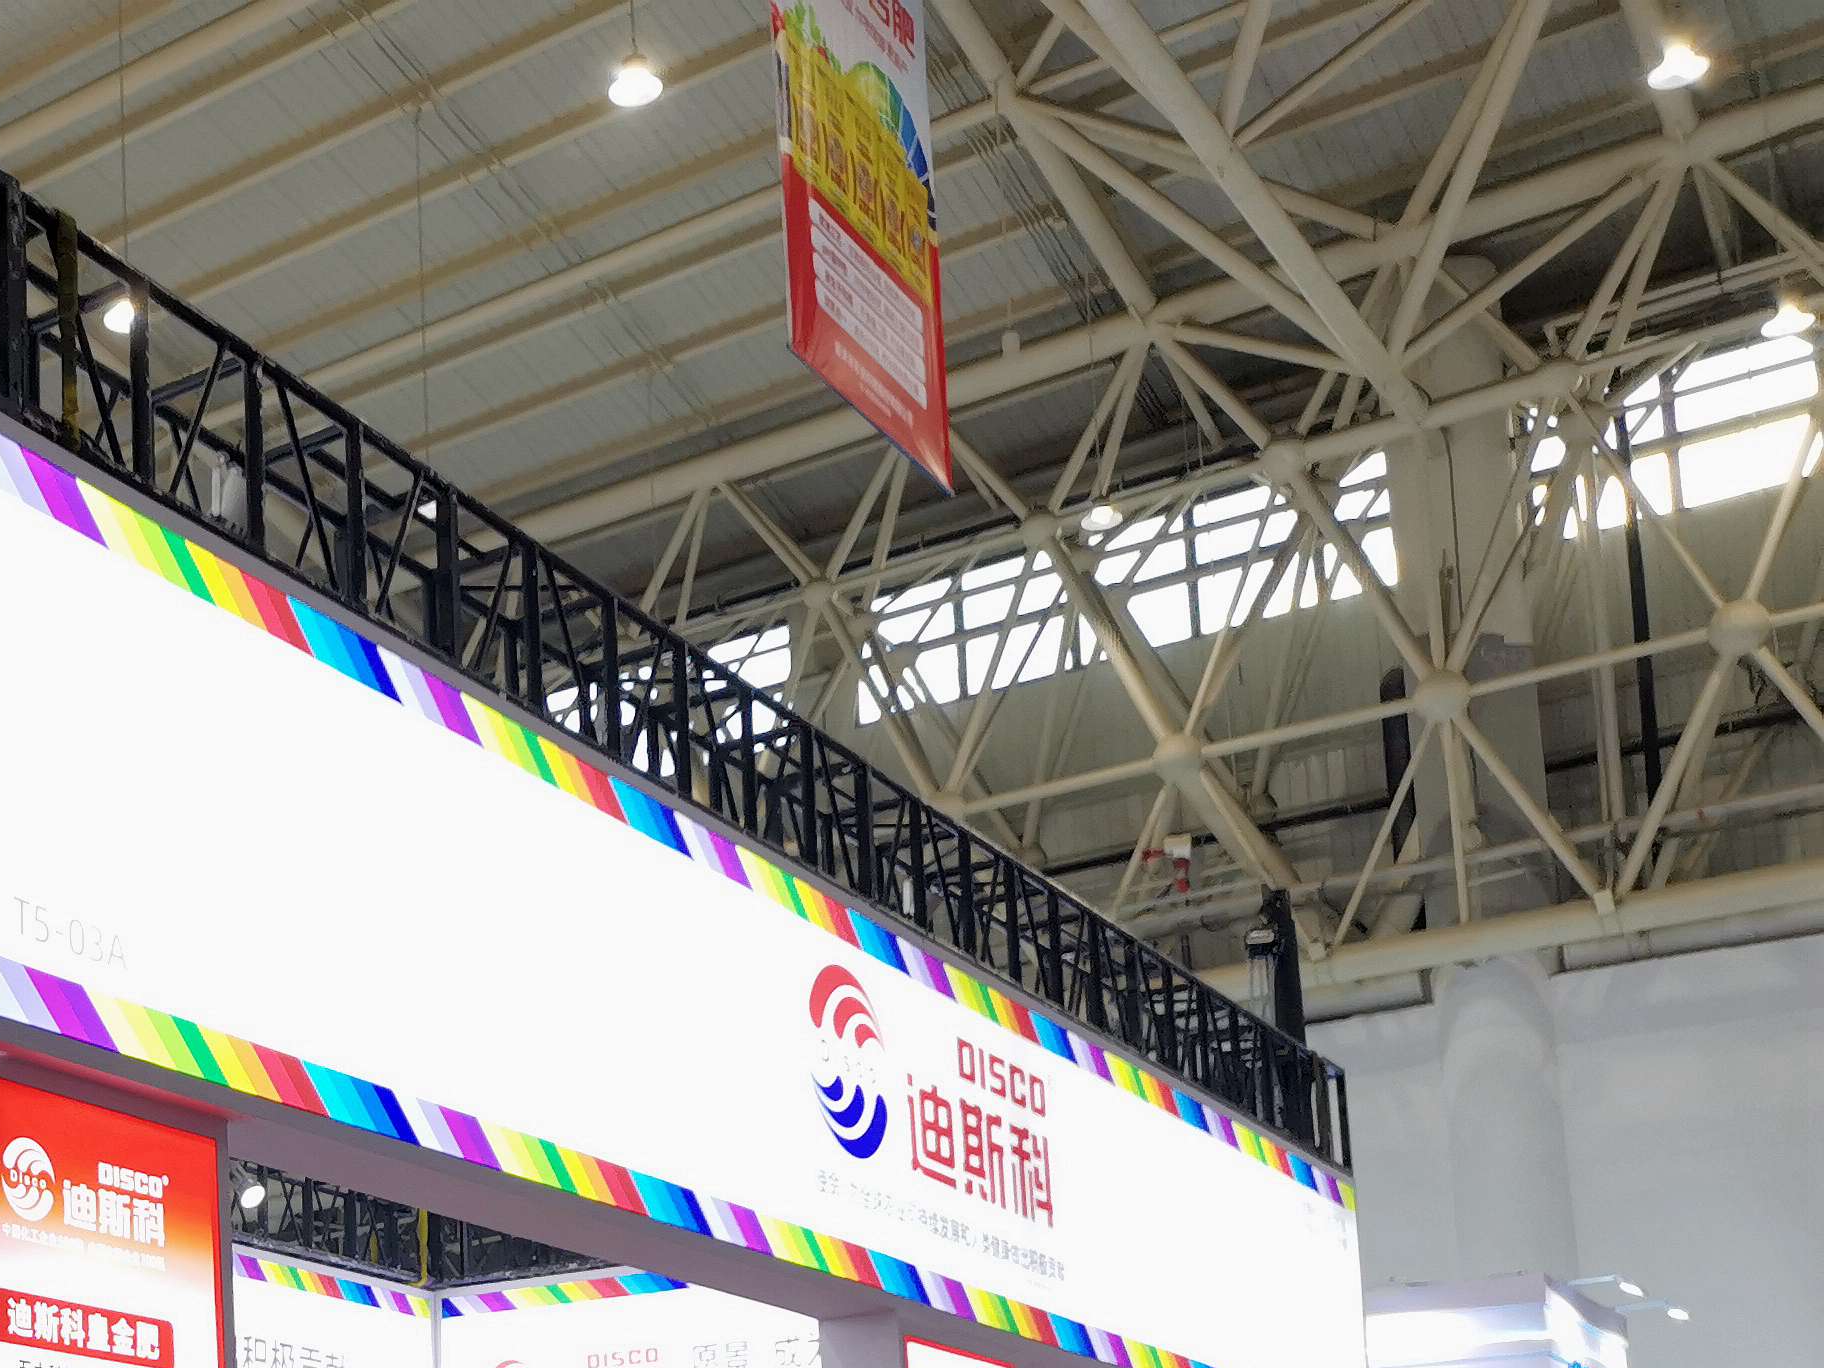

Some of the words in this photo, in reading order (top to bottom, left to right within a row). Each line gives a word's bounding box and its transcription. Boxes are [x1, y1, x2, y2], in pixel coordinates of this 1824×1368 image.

[13, 895, 128, 970] T5-03A
[957, 1036, 1047, 1118] DISCO
[97, 1161, 164, 1199] DISCO
[907, 1072, 1054, 1229] 迪斯科
[62, 1179, 166, 1248] 迪斯科
